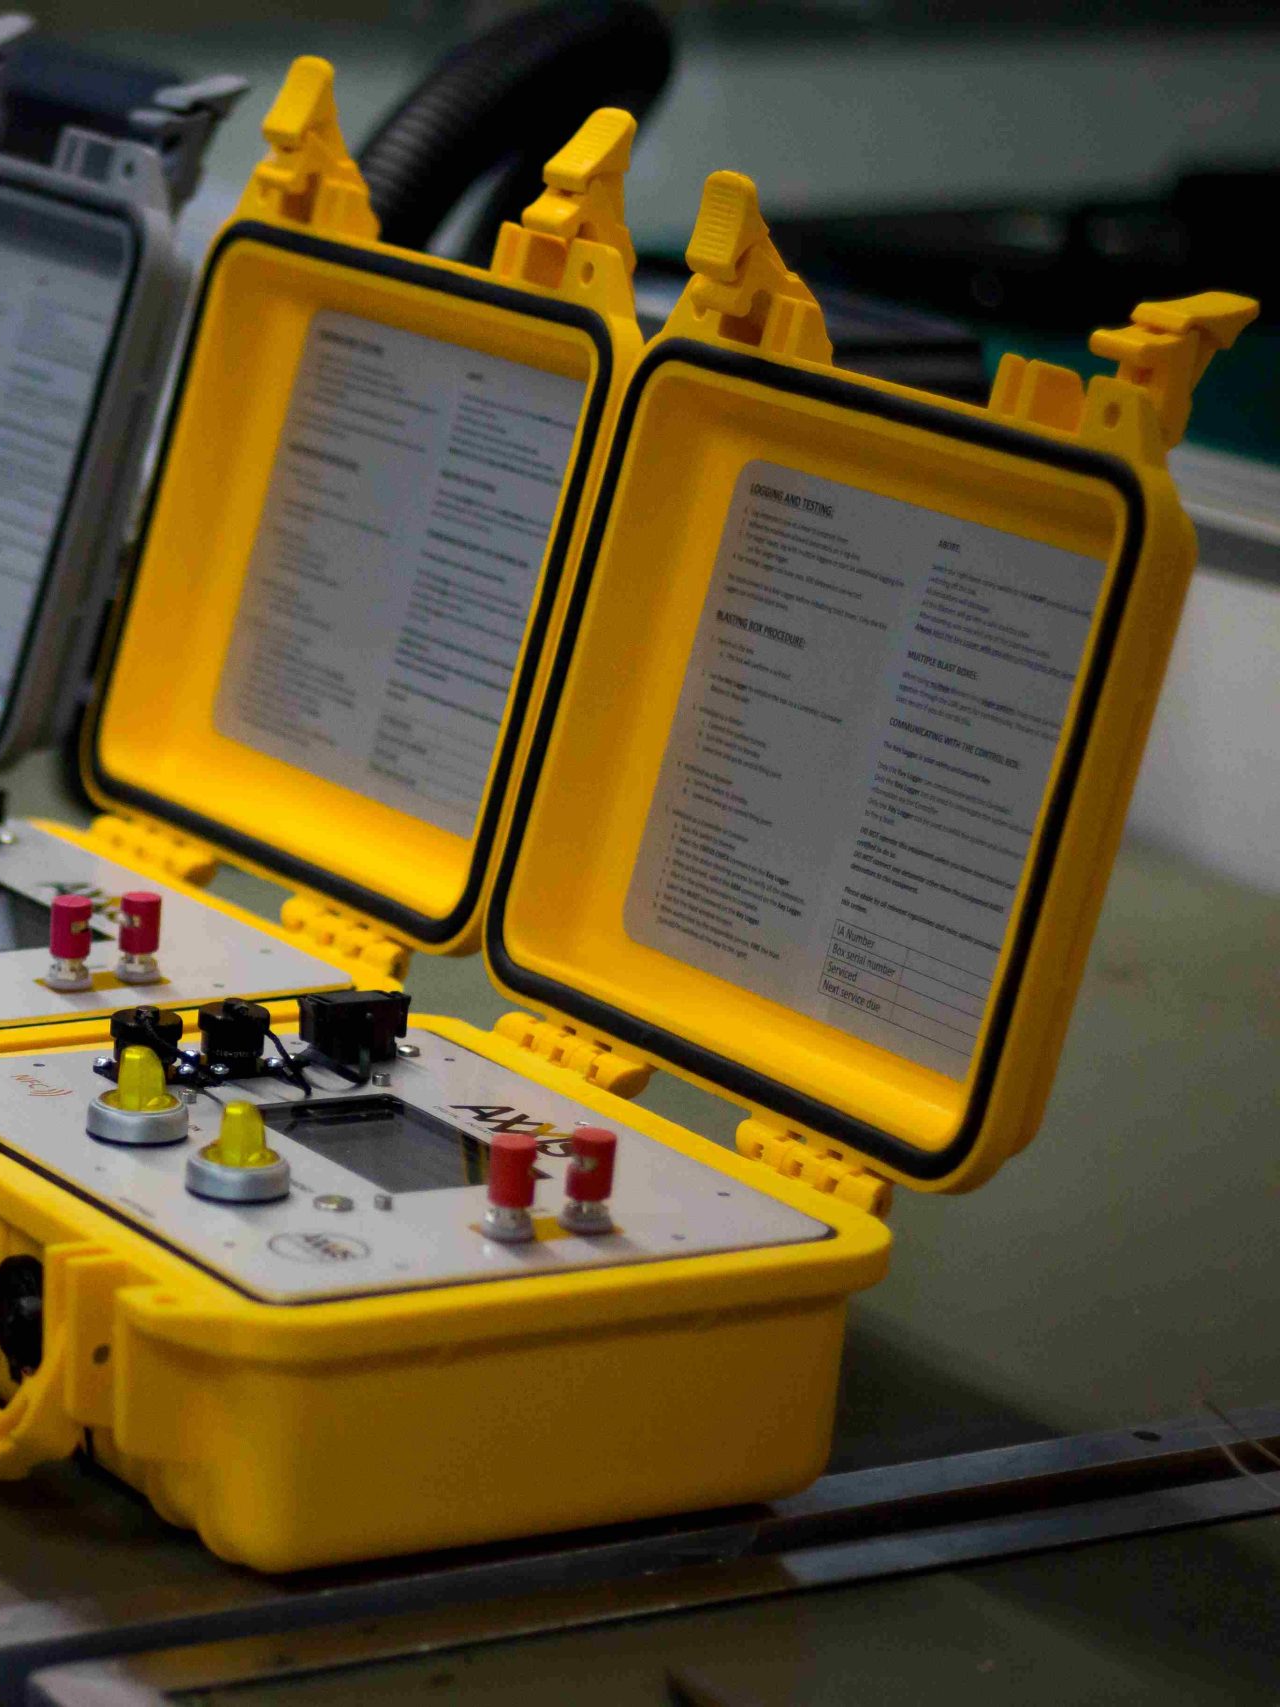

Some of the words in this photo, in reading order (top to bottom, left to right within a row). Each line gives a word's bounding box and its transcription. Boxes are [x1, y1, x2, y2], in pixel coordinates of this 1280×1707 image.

[748, 481, 784, 502] LOGGING
[783, 492, 802, 508] AND
[715, 609, 749, 630] BLASTING
[747, 619, 763, 634] BOX
[906, 649, 936, 667] MULTIPLE
[936, 659, 955, 673] BLAST
[887, 716, 944, 744] COMMUNICATING
[942, 735, 961, 749] WITH
[961, 741, 974, 754] THE
[973, 745, 1005, 765] CONTROL
[835, 924, 846, 937] IA
[844, 927, 876, 949] Number
[826, 960, 858, 983] Serviced
[831, 942, 846, 958] Box
[845, 948, 866, 966] serial
[865, 956, 896, 978] number
[821, 979, 840, 996] Next
[839, 986, 866, 1007] service
[865, 997, 882, 1013] due
